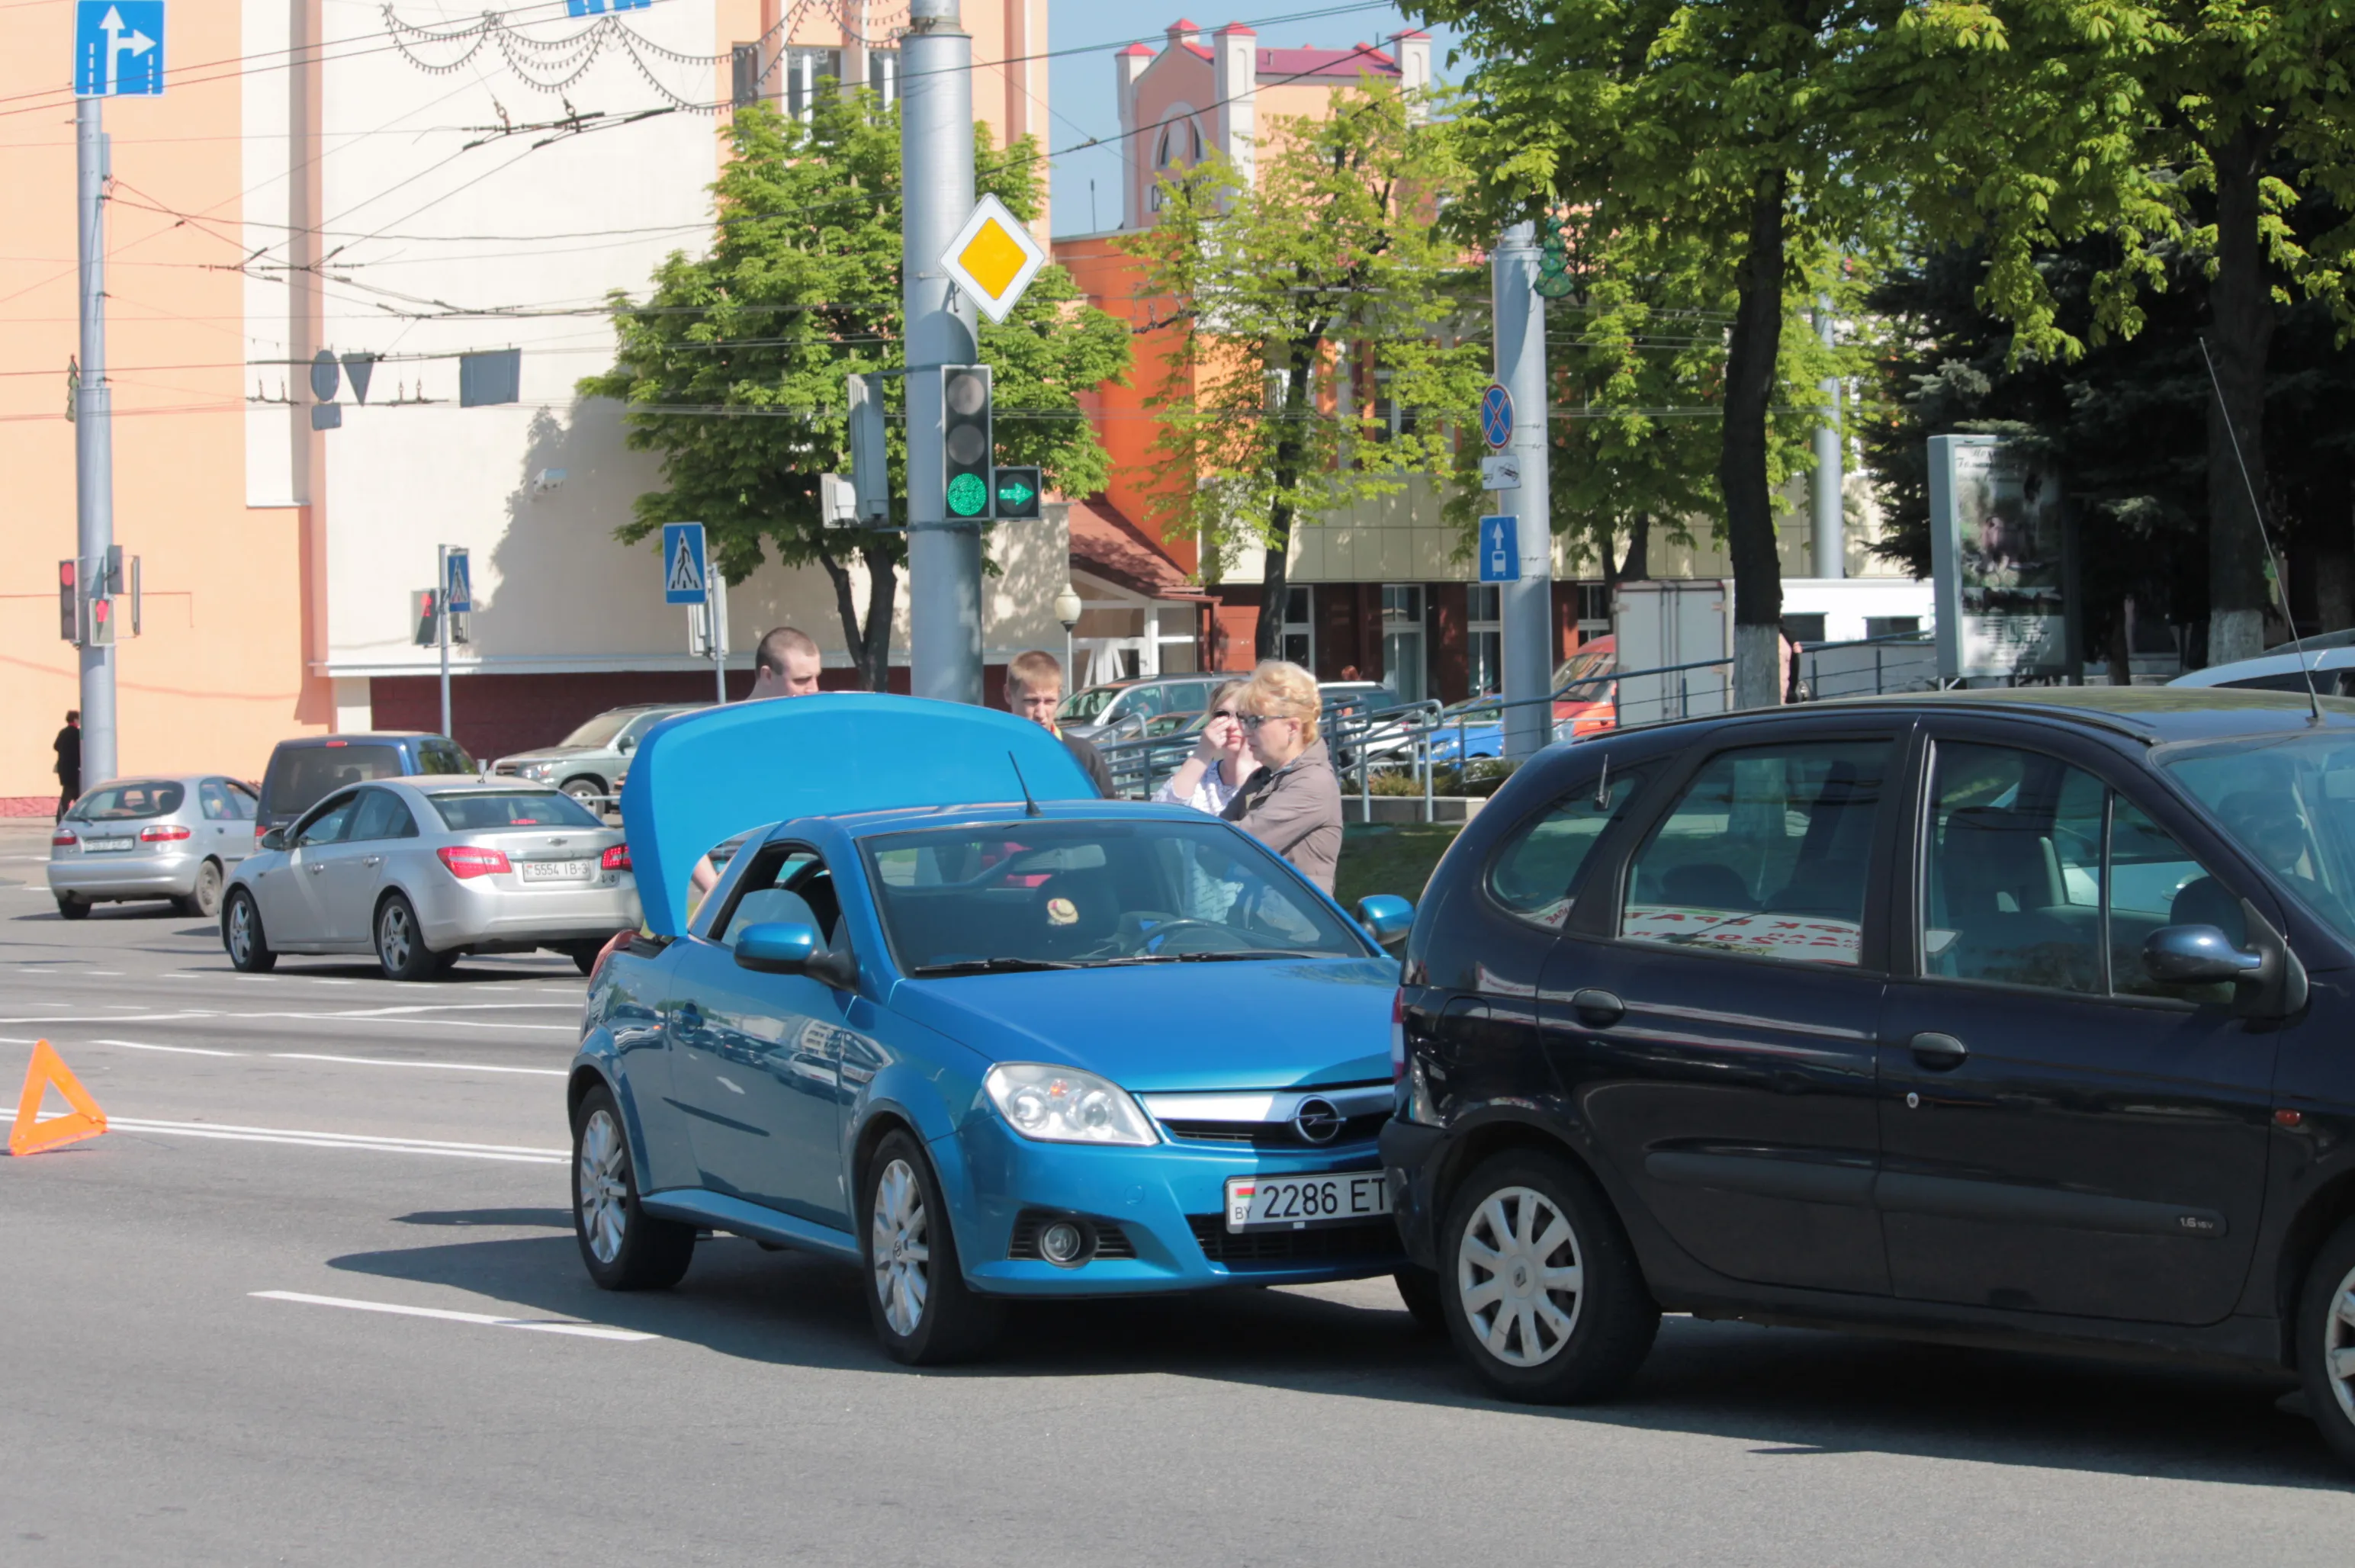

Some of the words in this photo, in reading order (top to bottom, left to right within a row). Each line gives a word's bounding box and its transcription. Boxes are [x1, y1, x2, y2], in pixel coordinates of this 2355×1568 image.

[535, 864, 559, 876] 5554
[1263, 1182, 1338, 1219] 2286
[1351, 1178, 1386, 1213] ET
[1235, 1206, 1252, 1220] BY
